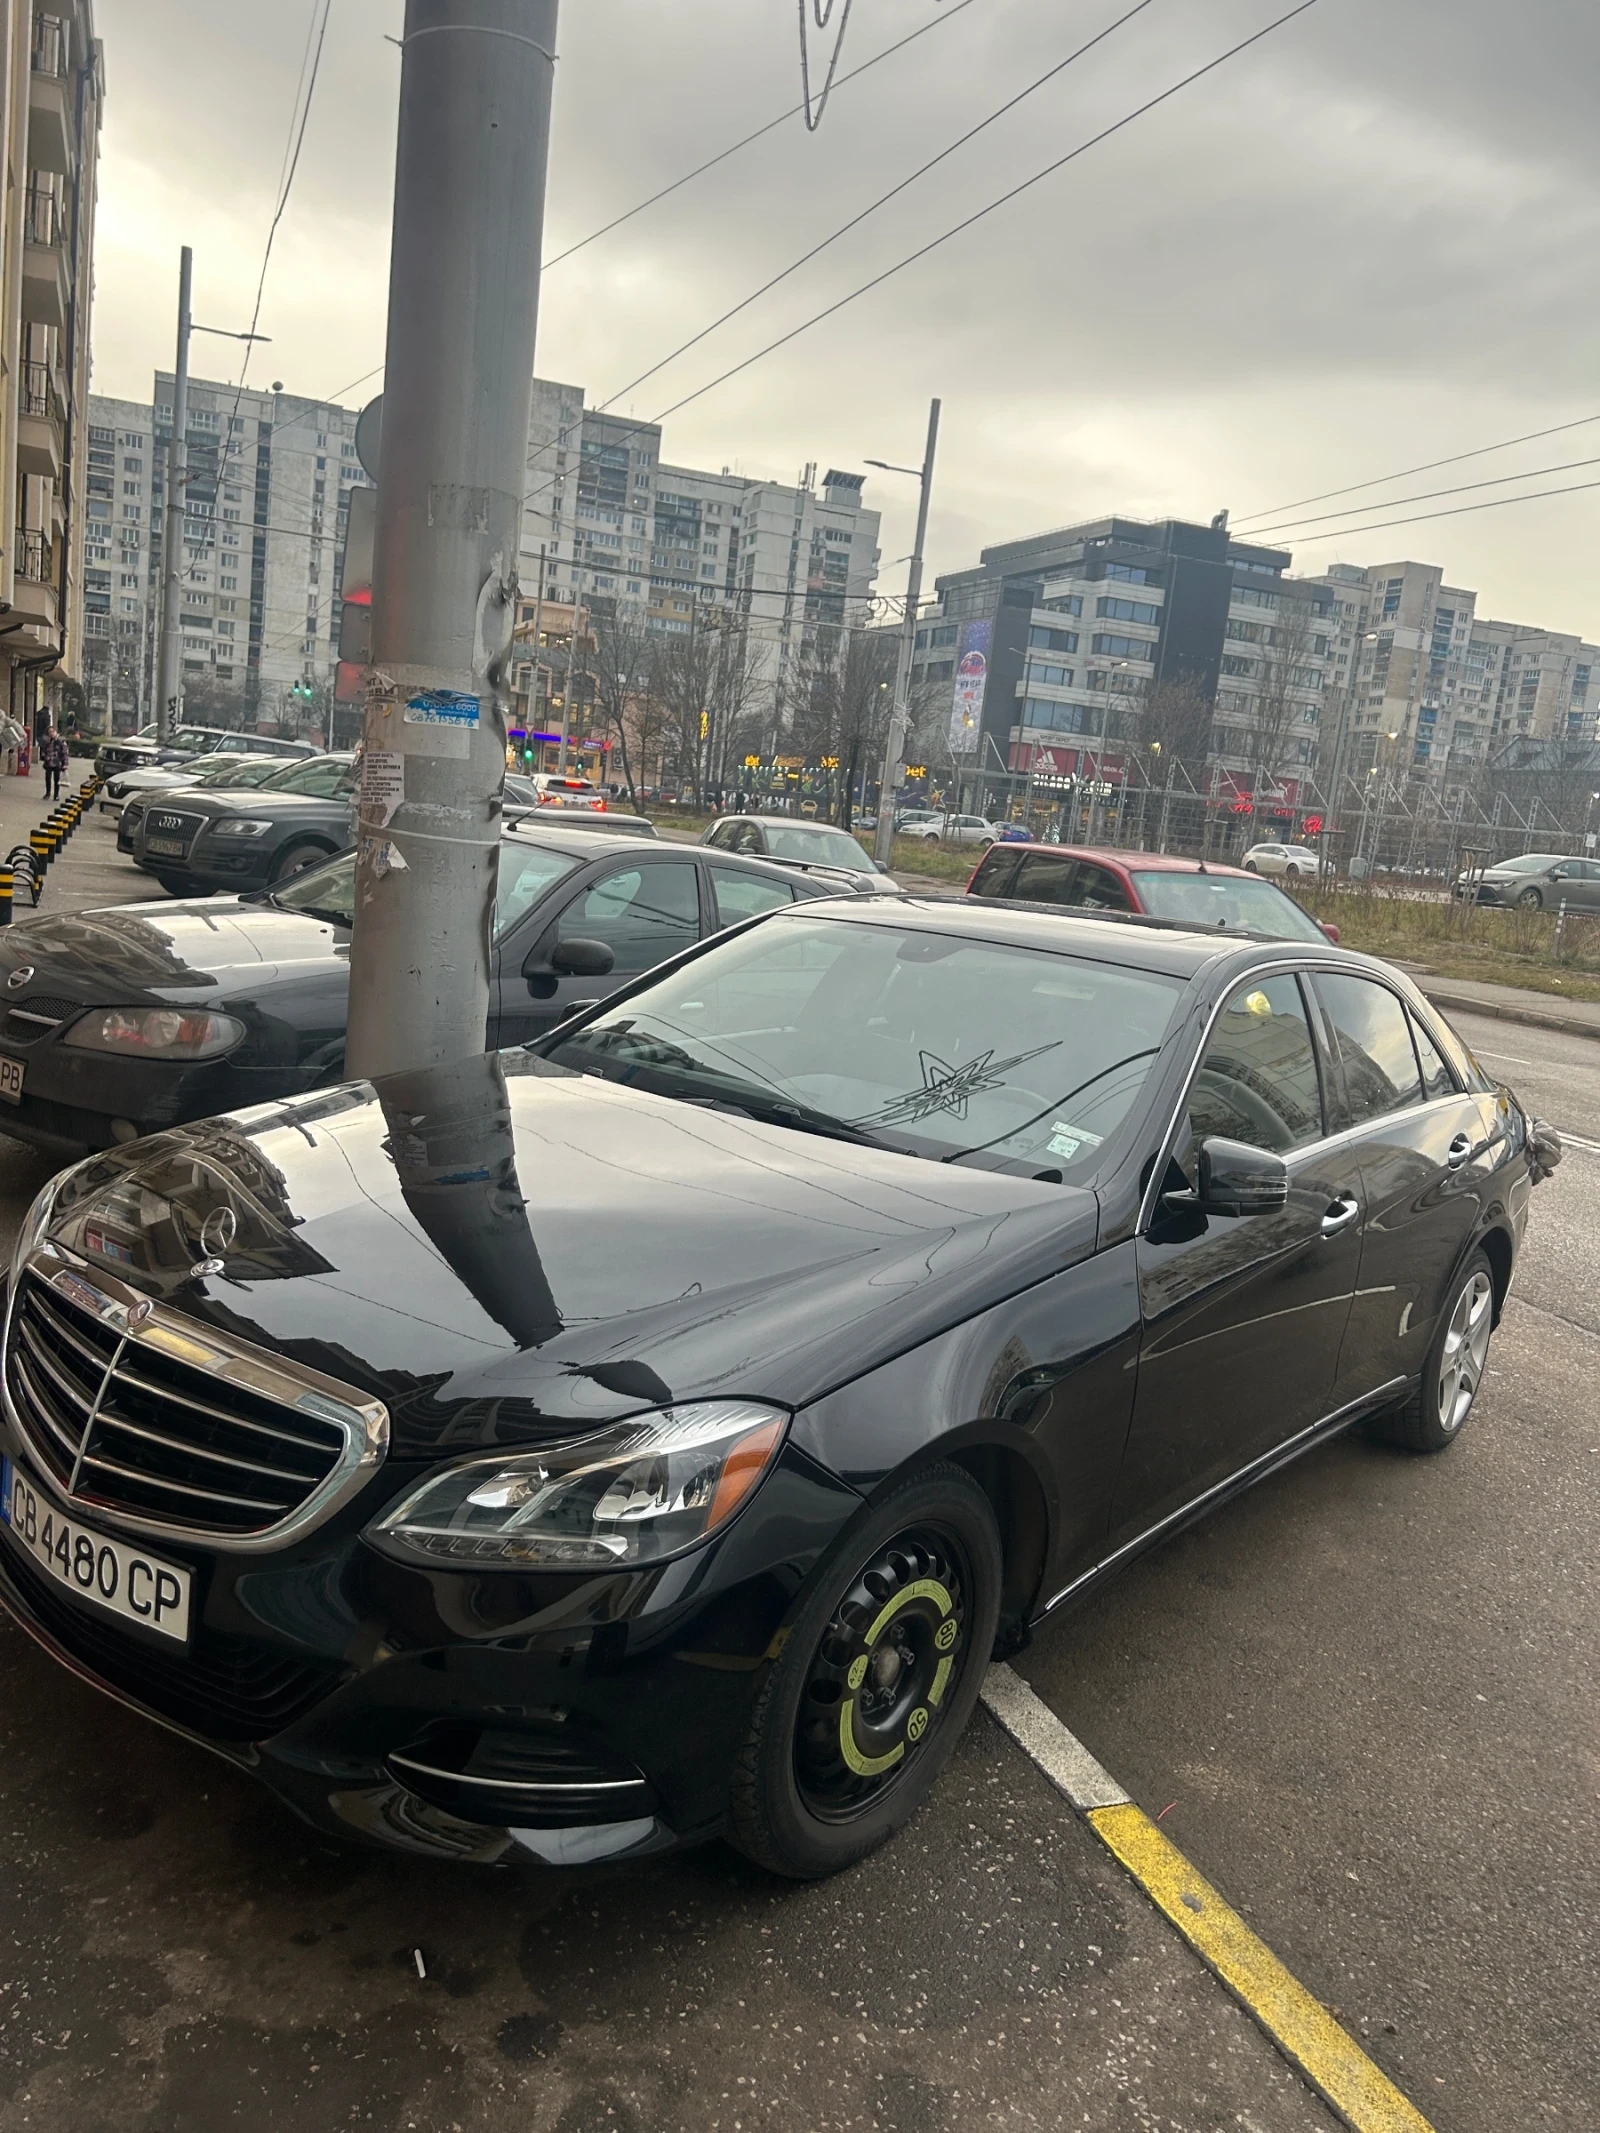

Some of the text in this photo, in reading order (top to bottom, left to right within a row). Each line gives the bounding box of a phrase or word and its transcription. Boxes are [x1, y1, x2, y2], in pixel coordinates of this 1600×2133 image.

[14, 1478, 181, 1623] CB 4480 CP
[940, 1621, 954, 1647] 80
[909, 1711, 927, 1739] 50
